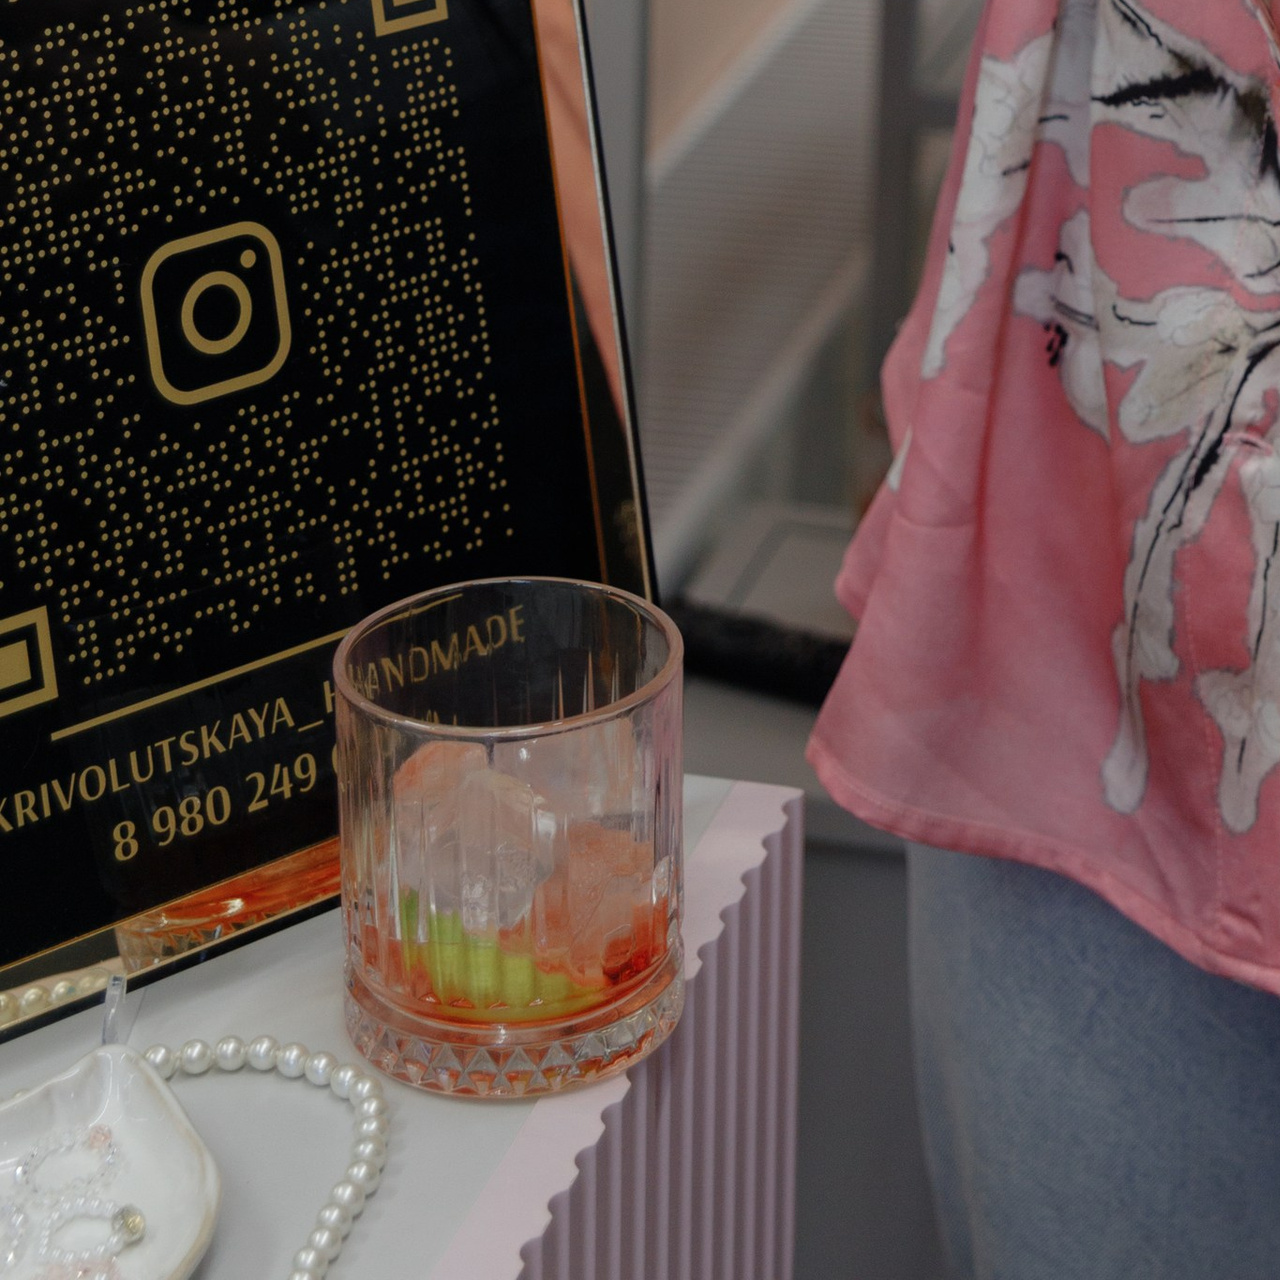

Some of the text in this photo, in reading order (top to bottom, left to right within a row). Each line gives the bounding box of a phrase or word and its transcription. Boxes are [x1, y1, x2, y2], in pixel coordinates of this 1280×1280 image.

[112, 820, 139, 862] 8
[152, 785, 231, 847] 980
[245, 752, 317, 813] 249
